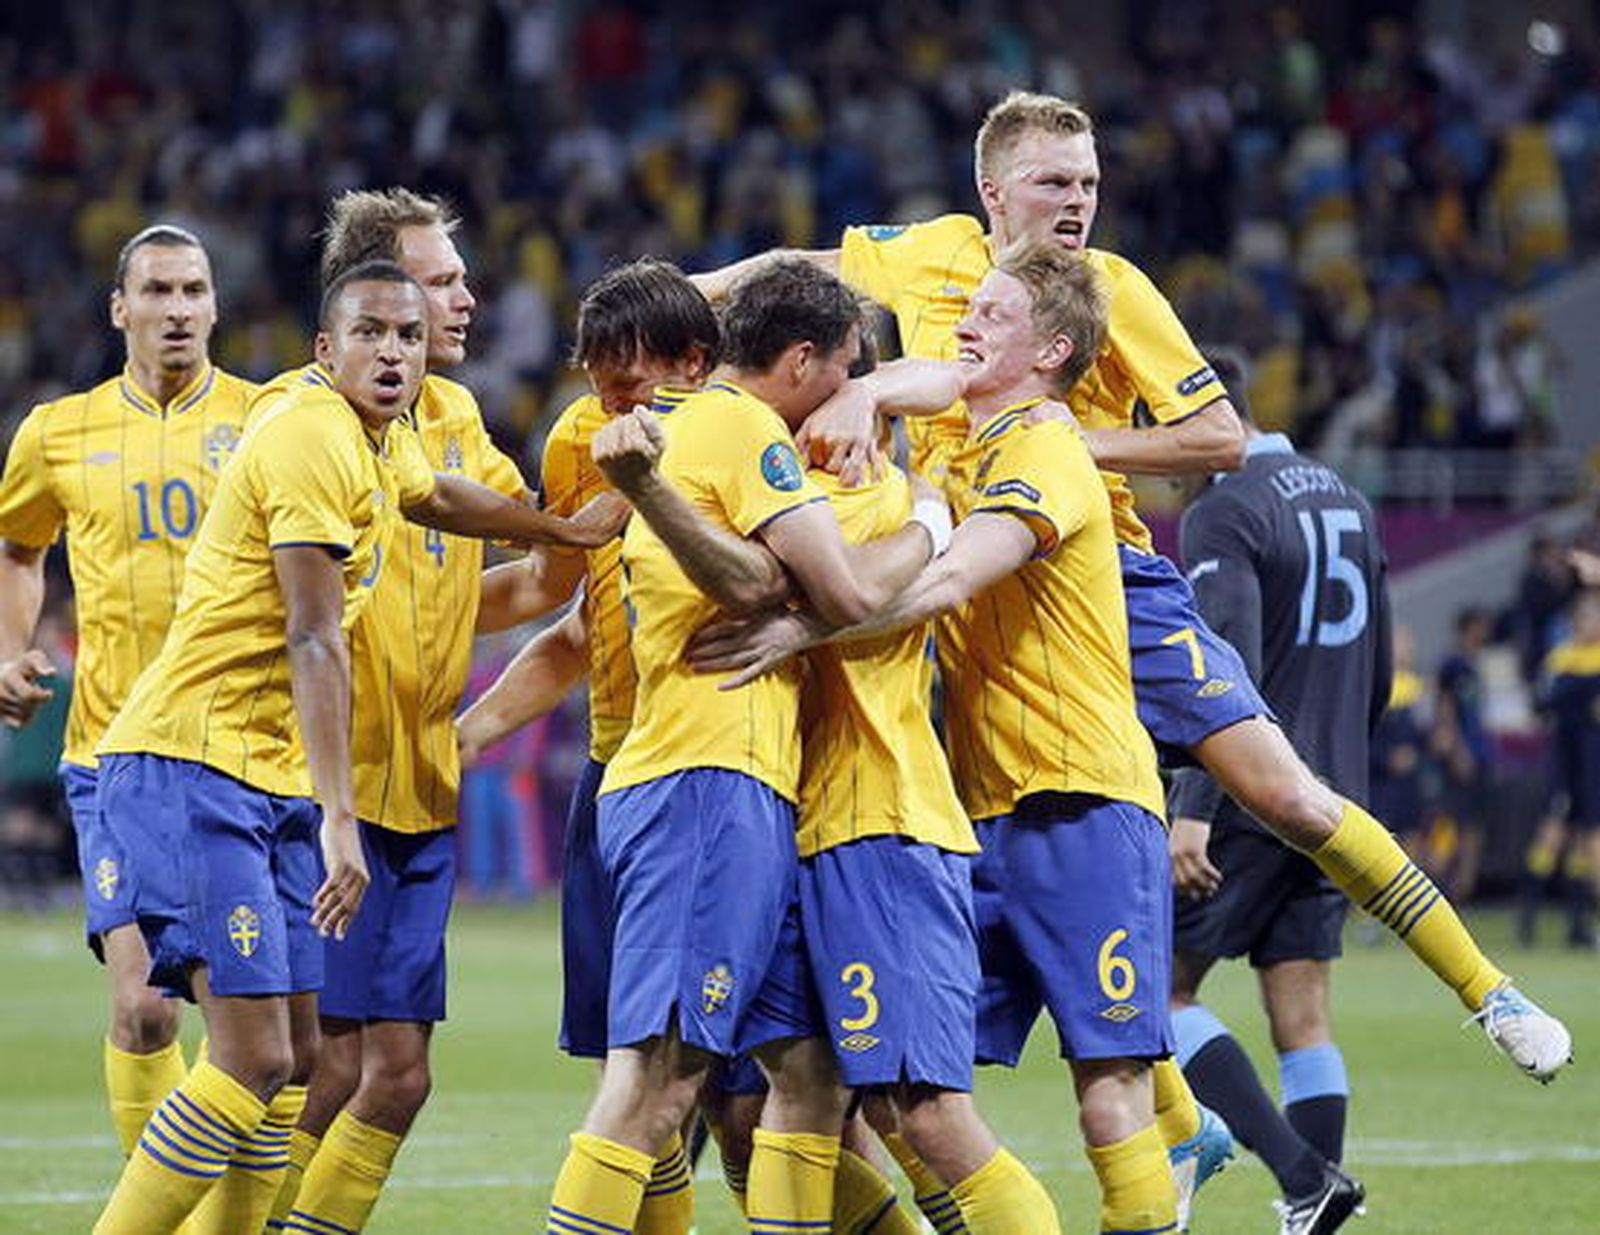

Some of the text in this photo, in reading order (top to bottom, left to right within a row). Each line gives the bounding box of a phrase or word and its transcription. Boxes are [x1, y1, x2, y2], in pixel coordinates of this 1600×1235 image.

[133, 479, 198, 541] 10
[1297, 508, 1369, 647] 15
[1163, 629, 1206, 680] 7
[840, 961, 880, 1032] 3
[1098, 928, 1136, 1000] 6
